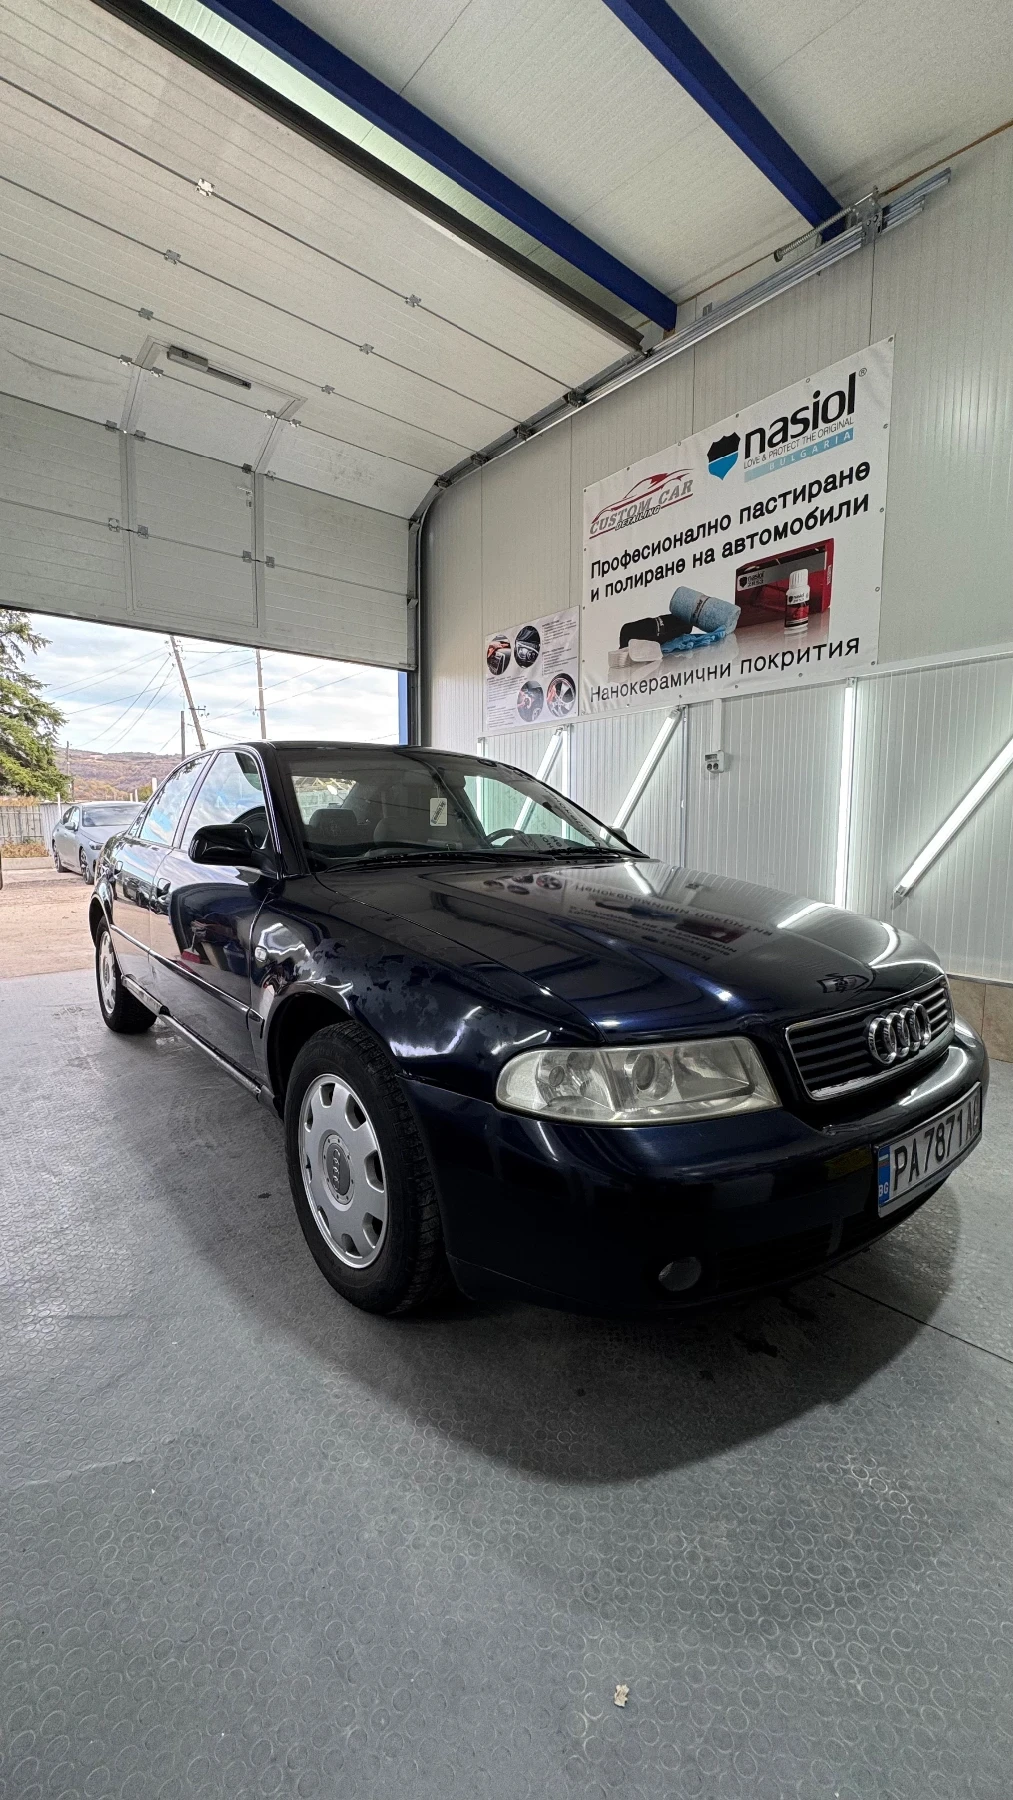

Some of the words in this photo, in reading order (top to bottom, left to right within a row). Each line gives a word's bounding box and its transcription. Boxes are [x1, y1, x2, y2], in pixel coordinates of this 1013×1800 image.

[744, 456, 761, 470] LOVE
[762, 454, 767, 463] &
[768, 439, 801, 459] PROTECT
[802, 431, 816, 445] THE
[817, 417, 855, 439] ORIGINAL
[769, 431, 852, 471] BULGARIA
[589, 496, 653, 535] CUSTOM
[658, 479, 694, 505] CAR
[590, 587, 599, 602] и
[692, 547, 716, 569] на
[721, 493, 869, 559] автомобили
[589, 662, 732, 703] Нанокерамични
[740, 636, 860, 675] покрития
[878, 1181, 889, 1198] BG
